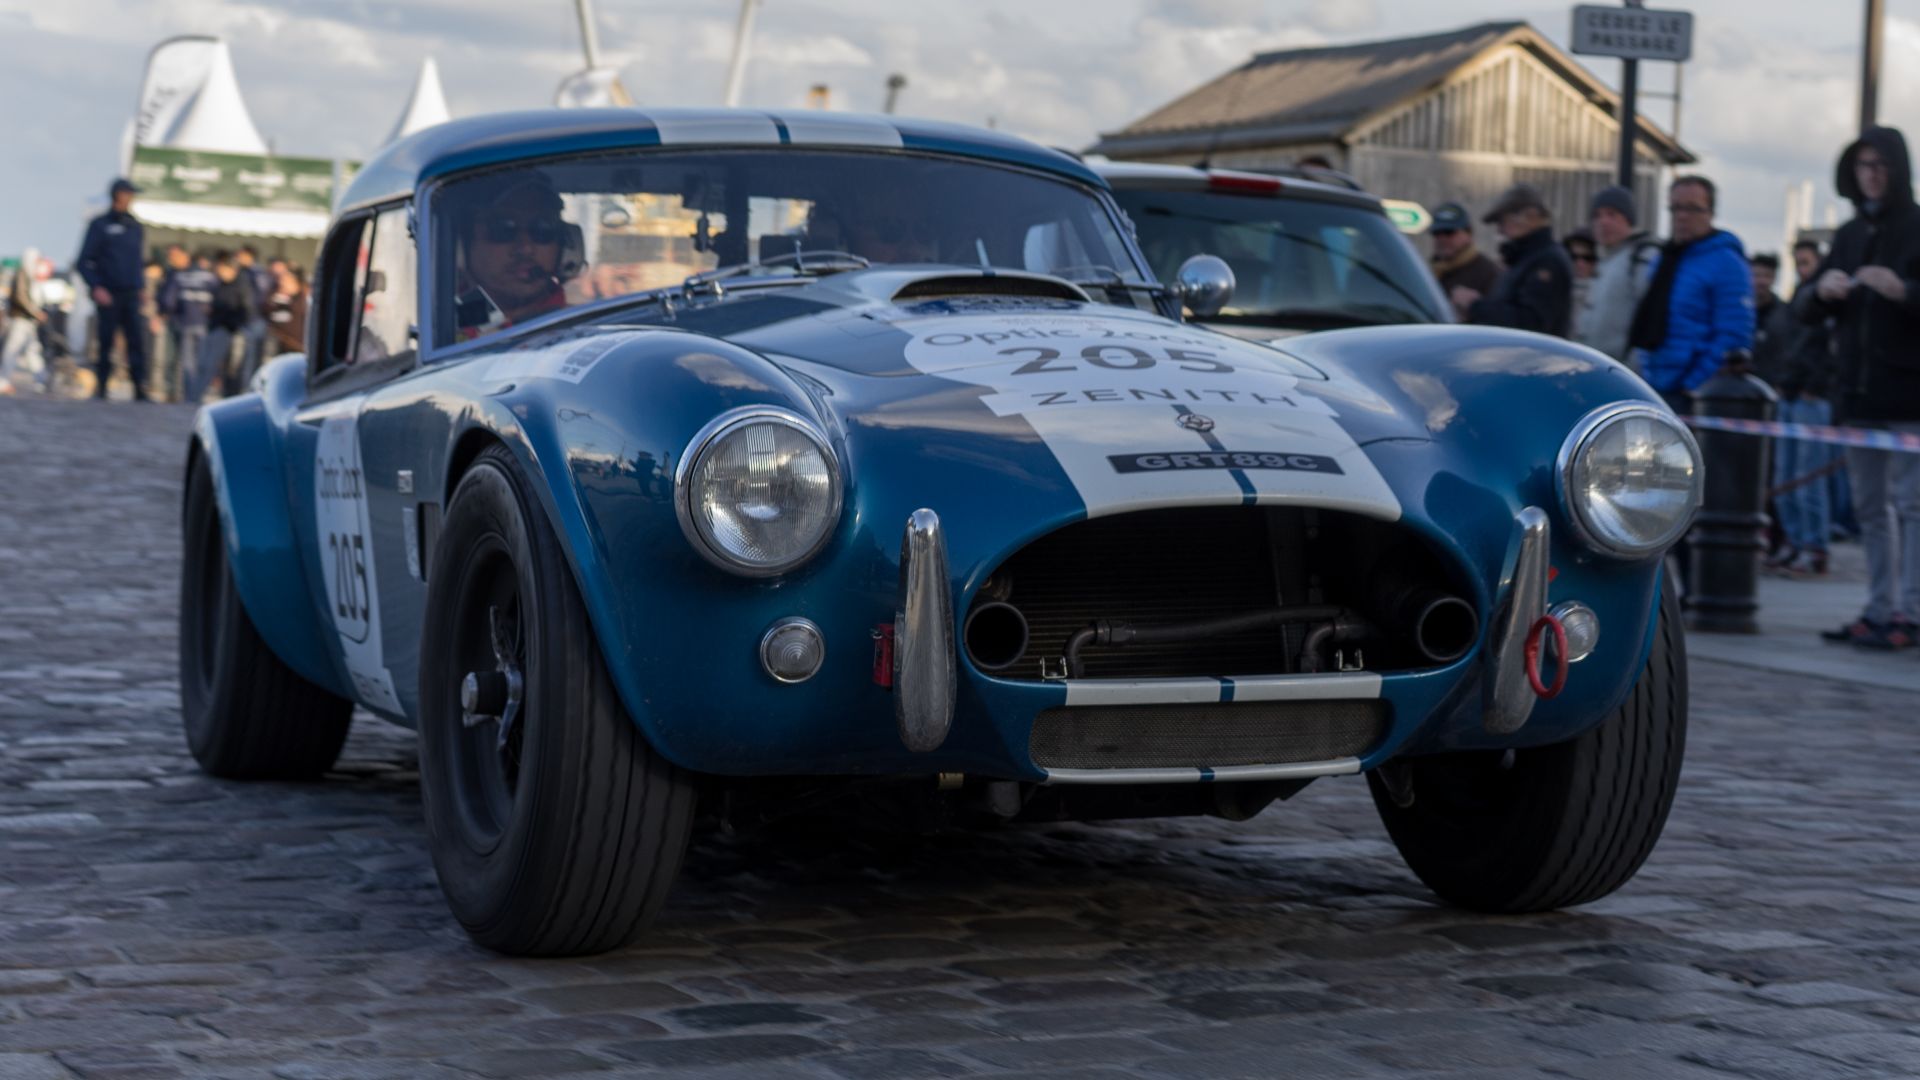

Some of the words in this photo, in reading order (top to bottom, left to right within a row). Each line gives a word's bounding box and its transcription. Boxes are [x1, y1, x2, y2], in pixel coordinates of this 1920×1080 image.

[1659, 17, 1681, 34] LE
[1589, 31, 1676, 51] PASSAGE
[924, 326, 1080, 346] Optic
[997, 345, 1235, 375] 205
[1030, 388, 1299, 407] ZENITH
[1136, 453, 1319, 470] GRT89C
[329, 533, 369, 622] 205
